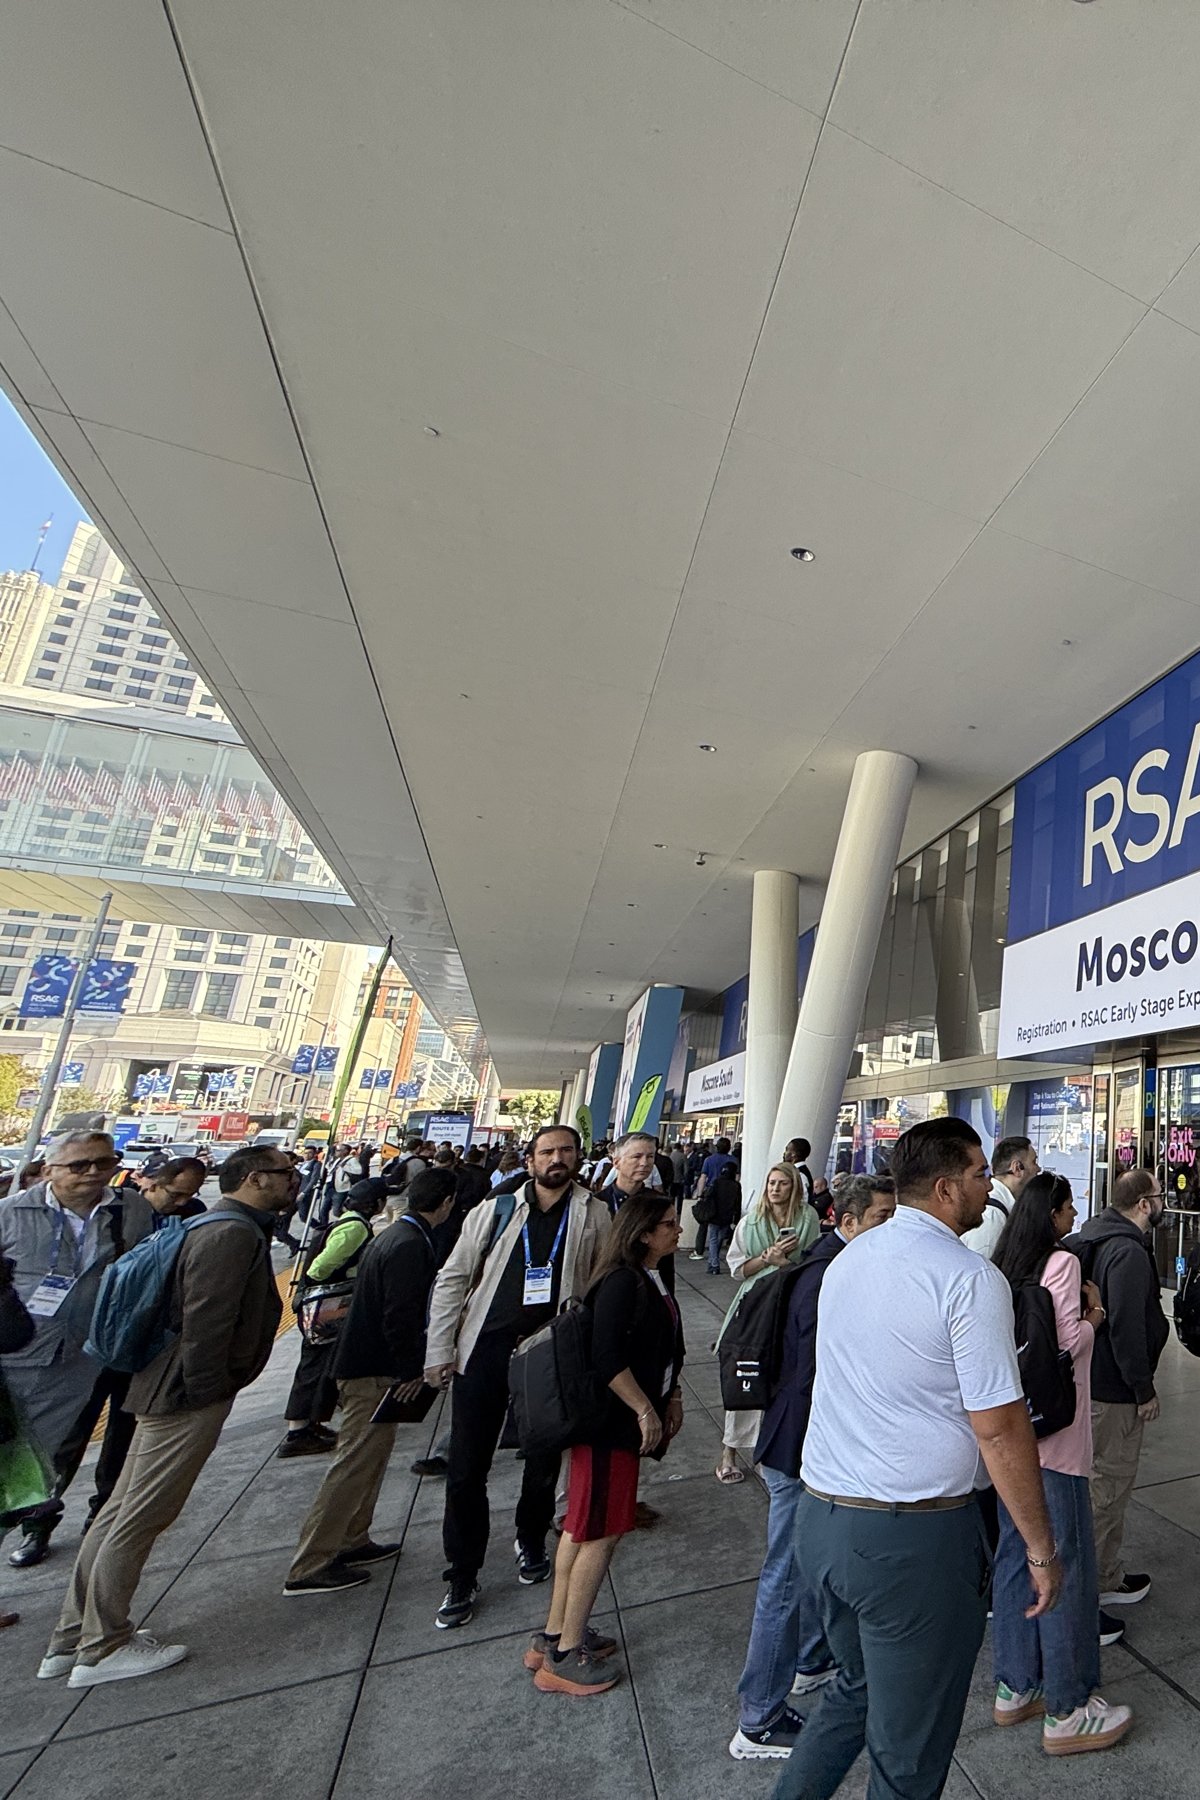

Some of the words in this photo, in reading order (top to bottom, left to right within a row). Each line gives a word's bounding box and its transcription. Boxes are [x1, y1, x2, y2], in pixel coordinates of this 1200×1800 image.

[1017, 1018, 1068, 1042] Registration
[1081, 1006, 1108, 1029] RSAC
[1110, 1001, 1138, 1025] Early
[1140, 996, 1175, 1018] Stage
[1171, 1126, 1193, 1143] Exit
[1168, 1144, 1196, 1167] Only
